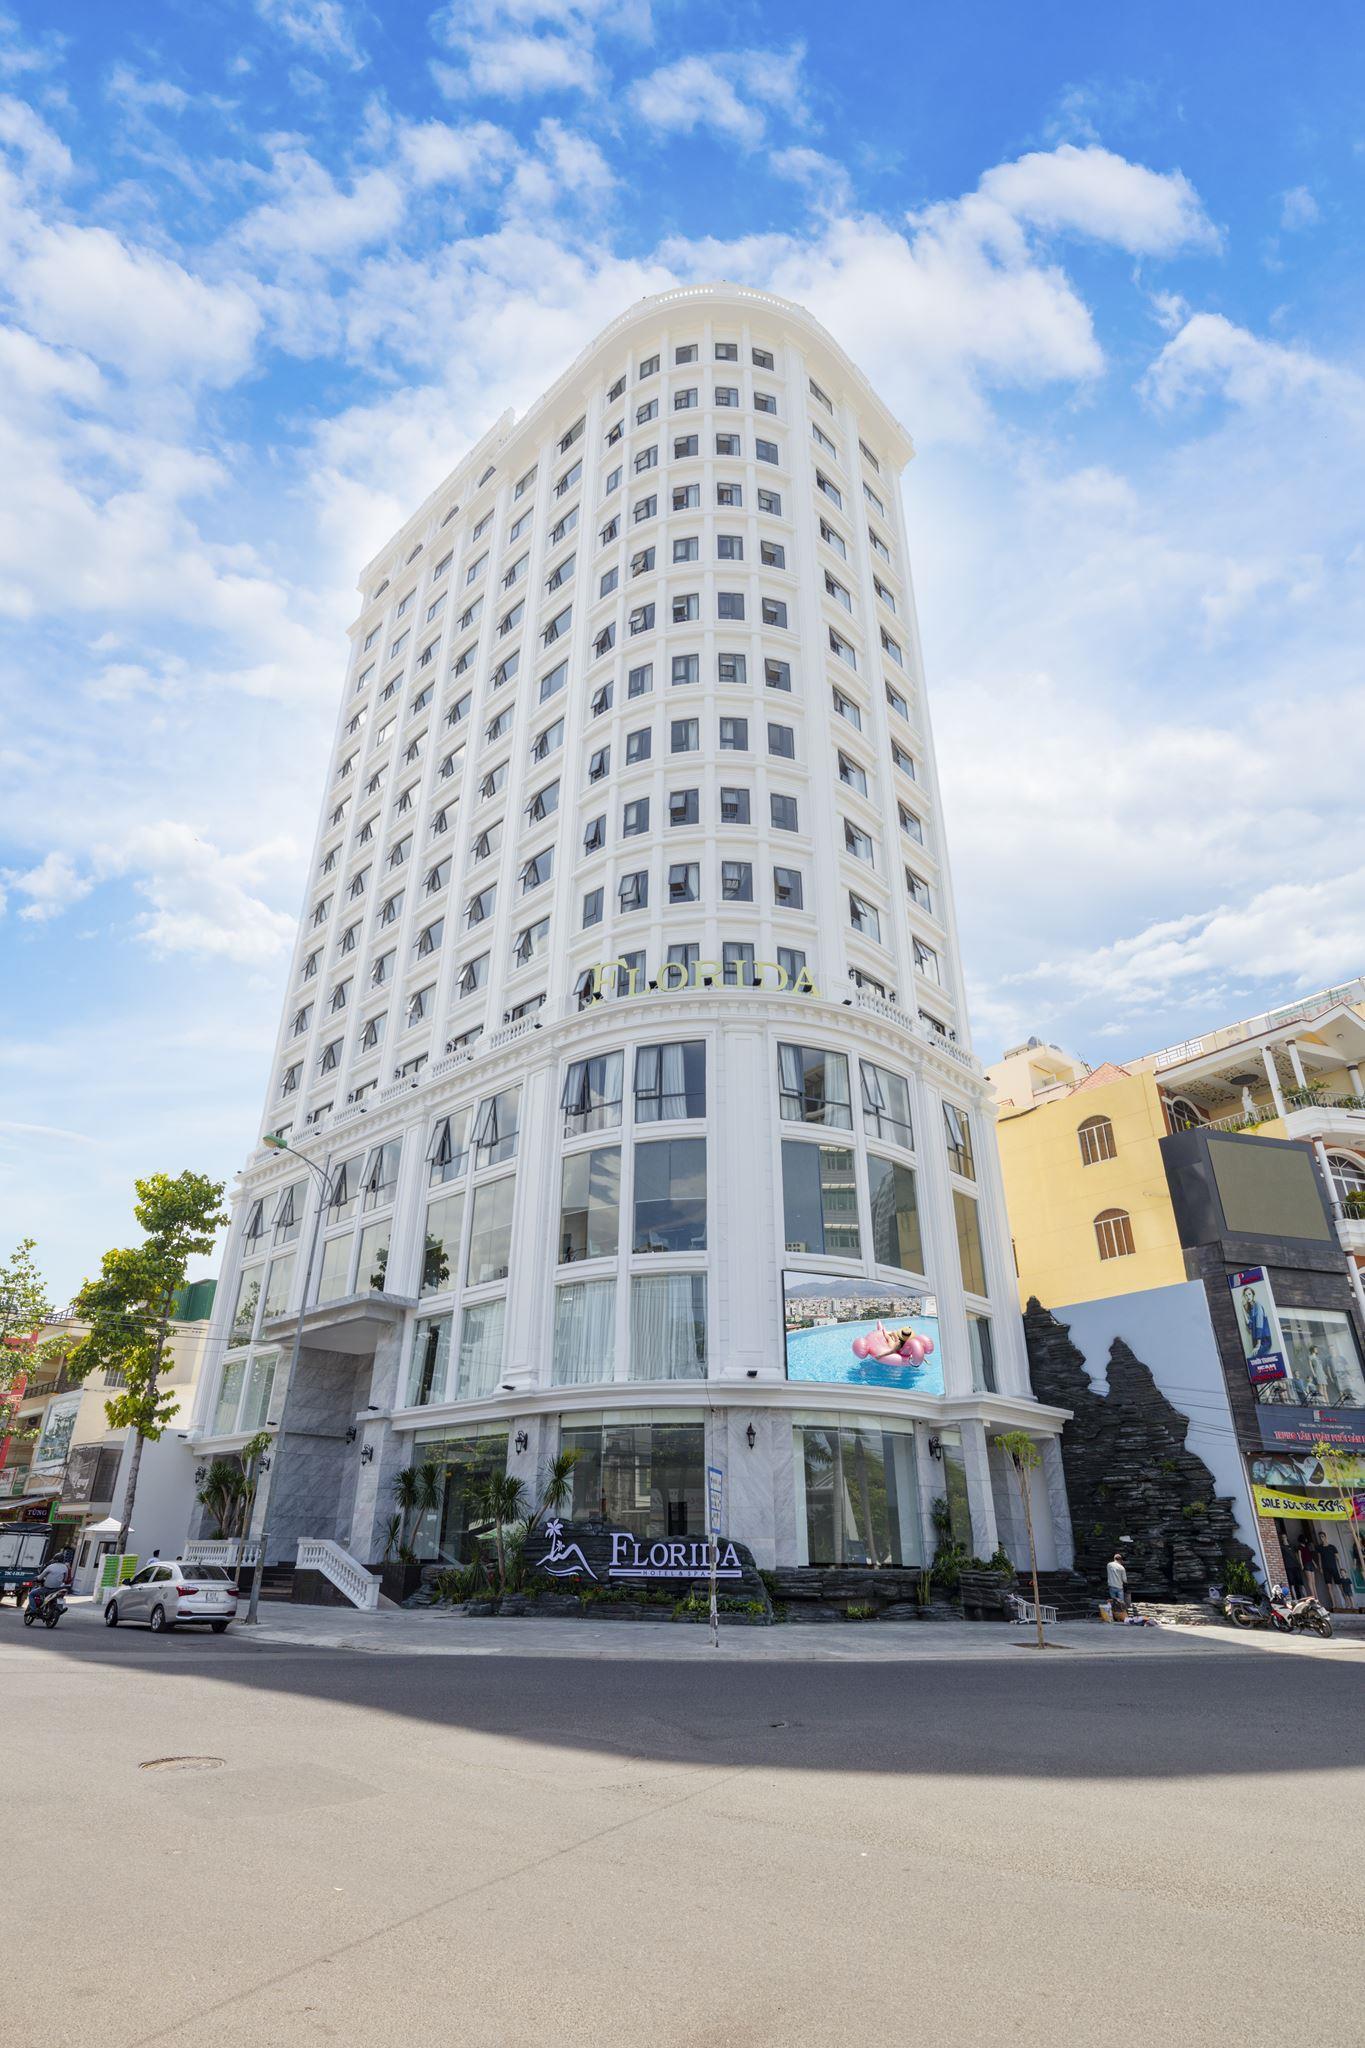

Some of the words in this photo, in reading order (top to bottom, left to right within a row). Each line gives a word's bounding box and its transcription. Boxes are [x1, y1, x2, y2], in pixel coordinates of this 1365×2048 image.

[589, 957, 823, 1005] FLORIDA
[1261, 1498, 1280, 1509] SALE
[1318, 1500, 1346, 1512] 50%
[609, 1533, 741, 1567] FLORIDA
